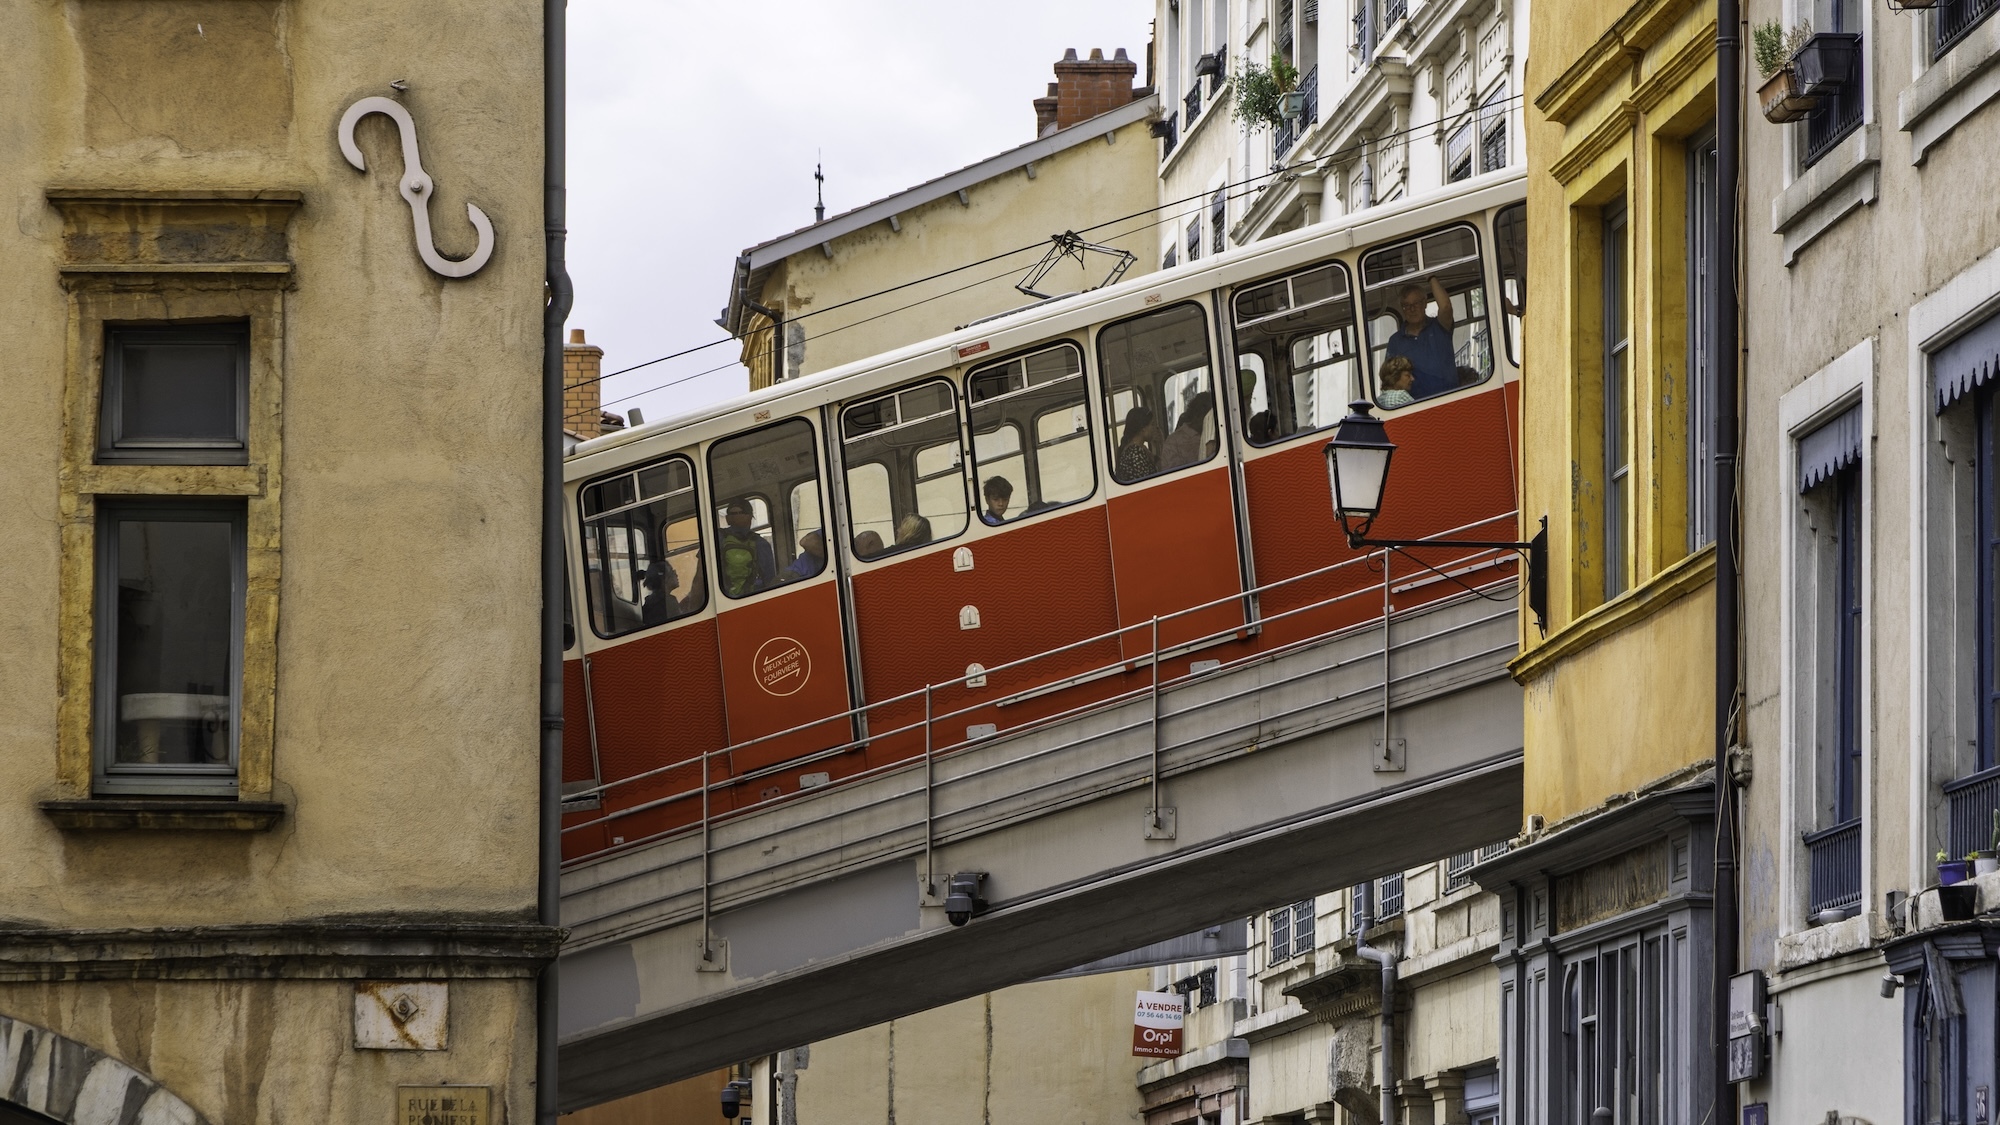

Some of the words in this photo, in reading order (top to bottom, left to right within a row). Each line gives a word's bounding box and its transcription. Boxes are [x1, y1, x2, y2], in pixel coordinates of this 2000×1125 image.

[763, 650, 801, 673] VIEUX-LYON
[1138, 1000, 1143, 1009] À
[1146, 1003, 1182, 1012] VENDRE
[1143, 1029, 1173, 1045] Orpi
[408, 1099, 438, 1111] RUE
[441, 1098, 457, 1111] DE
[460, 1099, 478, 1111] LA
